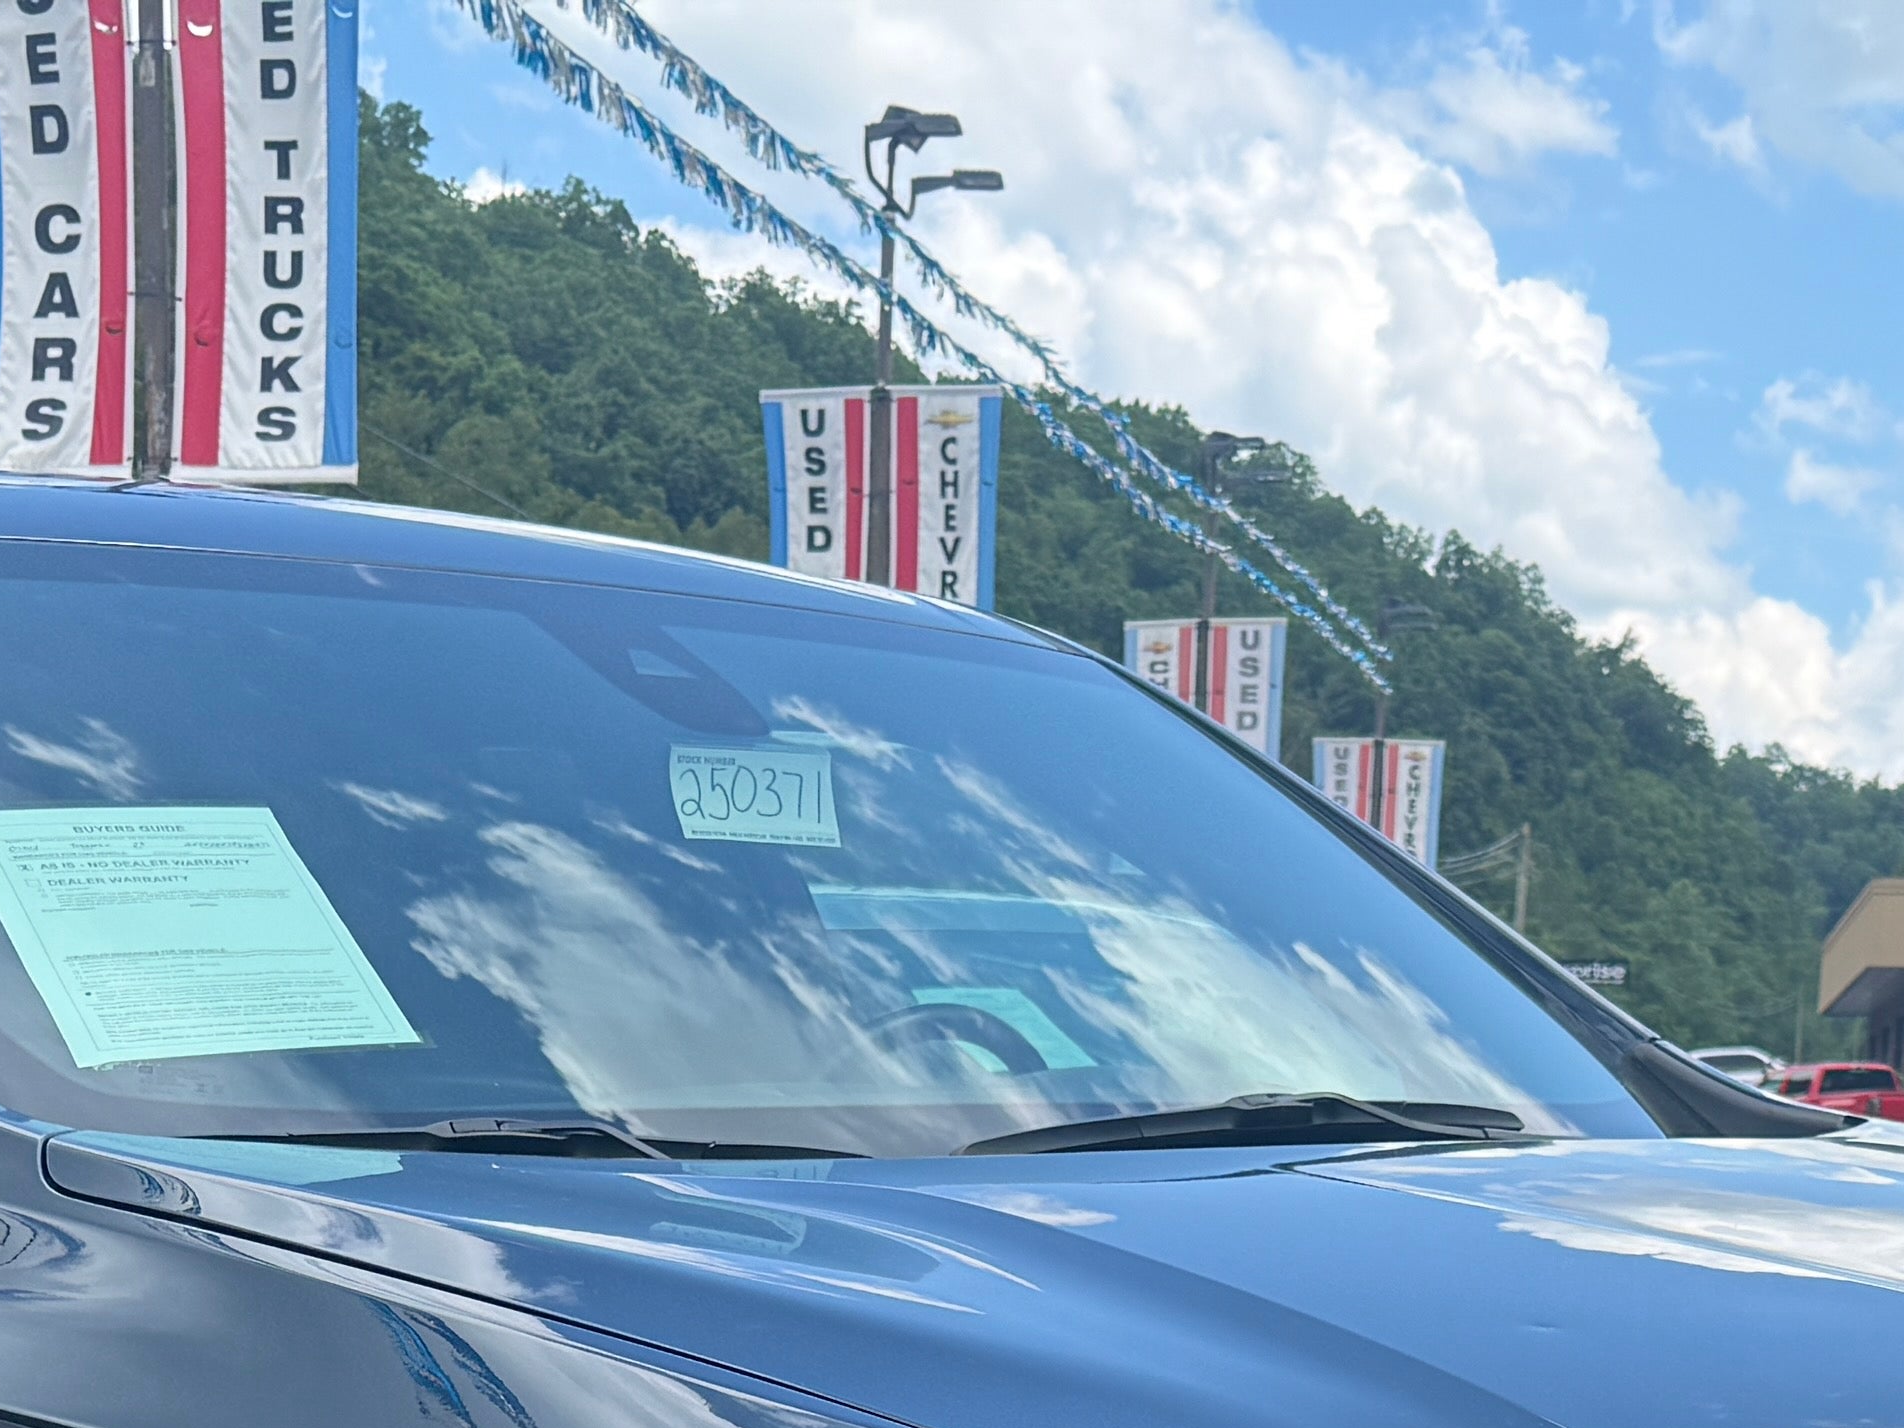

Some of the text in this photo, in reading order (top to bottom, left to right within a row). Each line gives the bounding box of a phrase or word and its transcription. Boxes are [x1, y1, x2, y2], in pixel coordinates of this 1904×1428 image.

[21, 204, 82, 441] CARS
[256, 139, 305, 442] TRUCKS
[800, 408, 833, 553] USED
[1236, 629, 1261, 732] USED
[73, 825, 186, 834] BUYERS GUIDE
[679, 764, 822, 824] 250371
[47, 875, 189, 887] DEALER WARRANTY
[88, 861, 110, 869] NO
[112, 860, 169, 868] DEALER
[171, 859, 250, 867] WARRANTY
